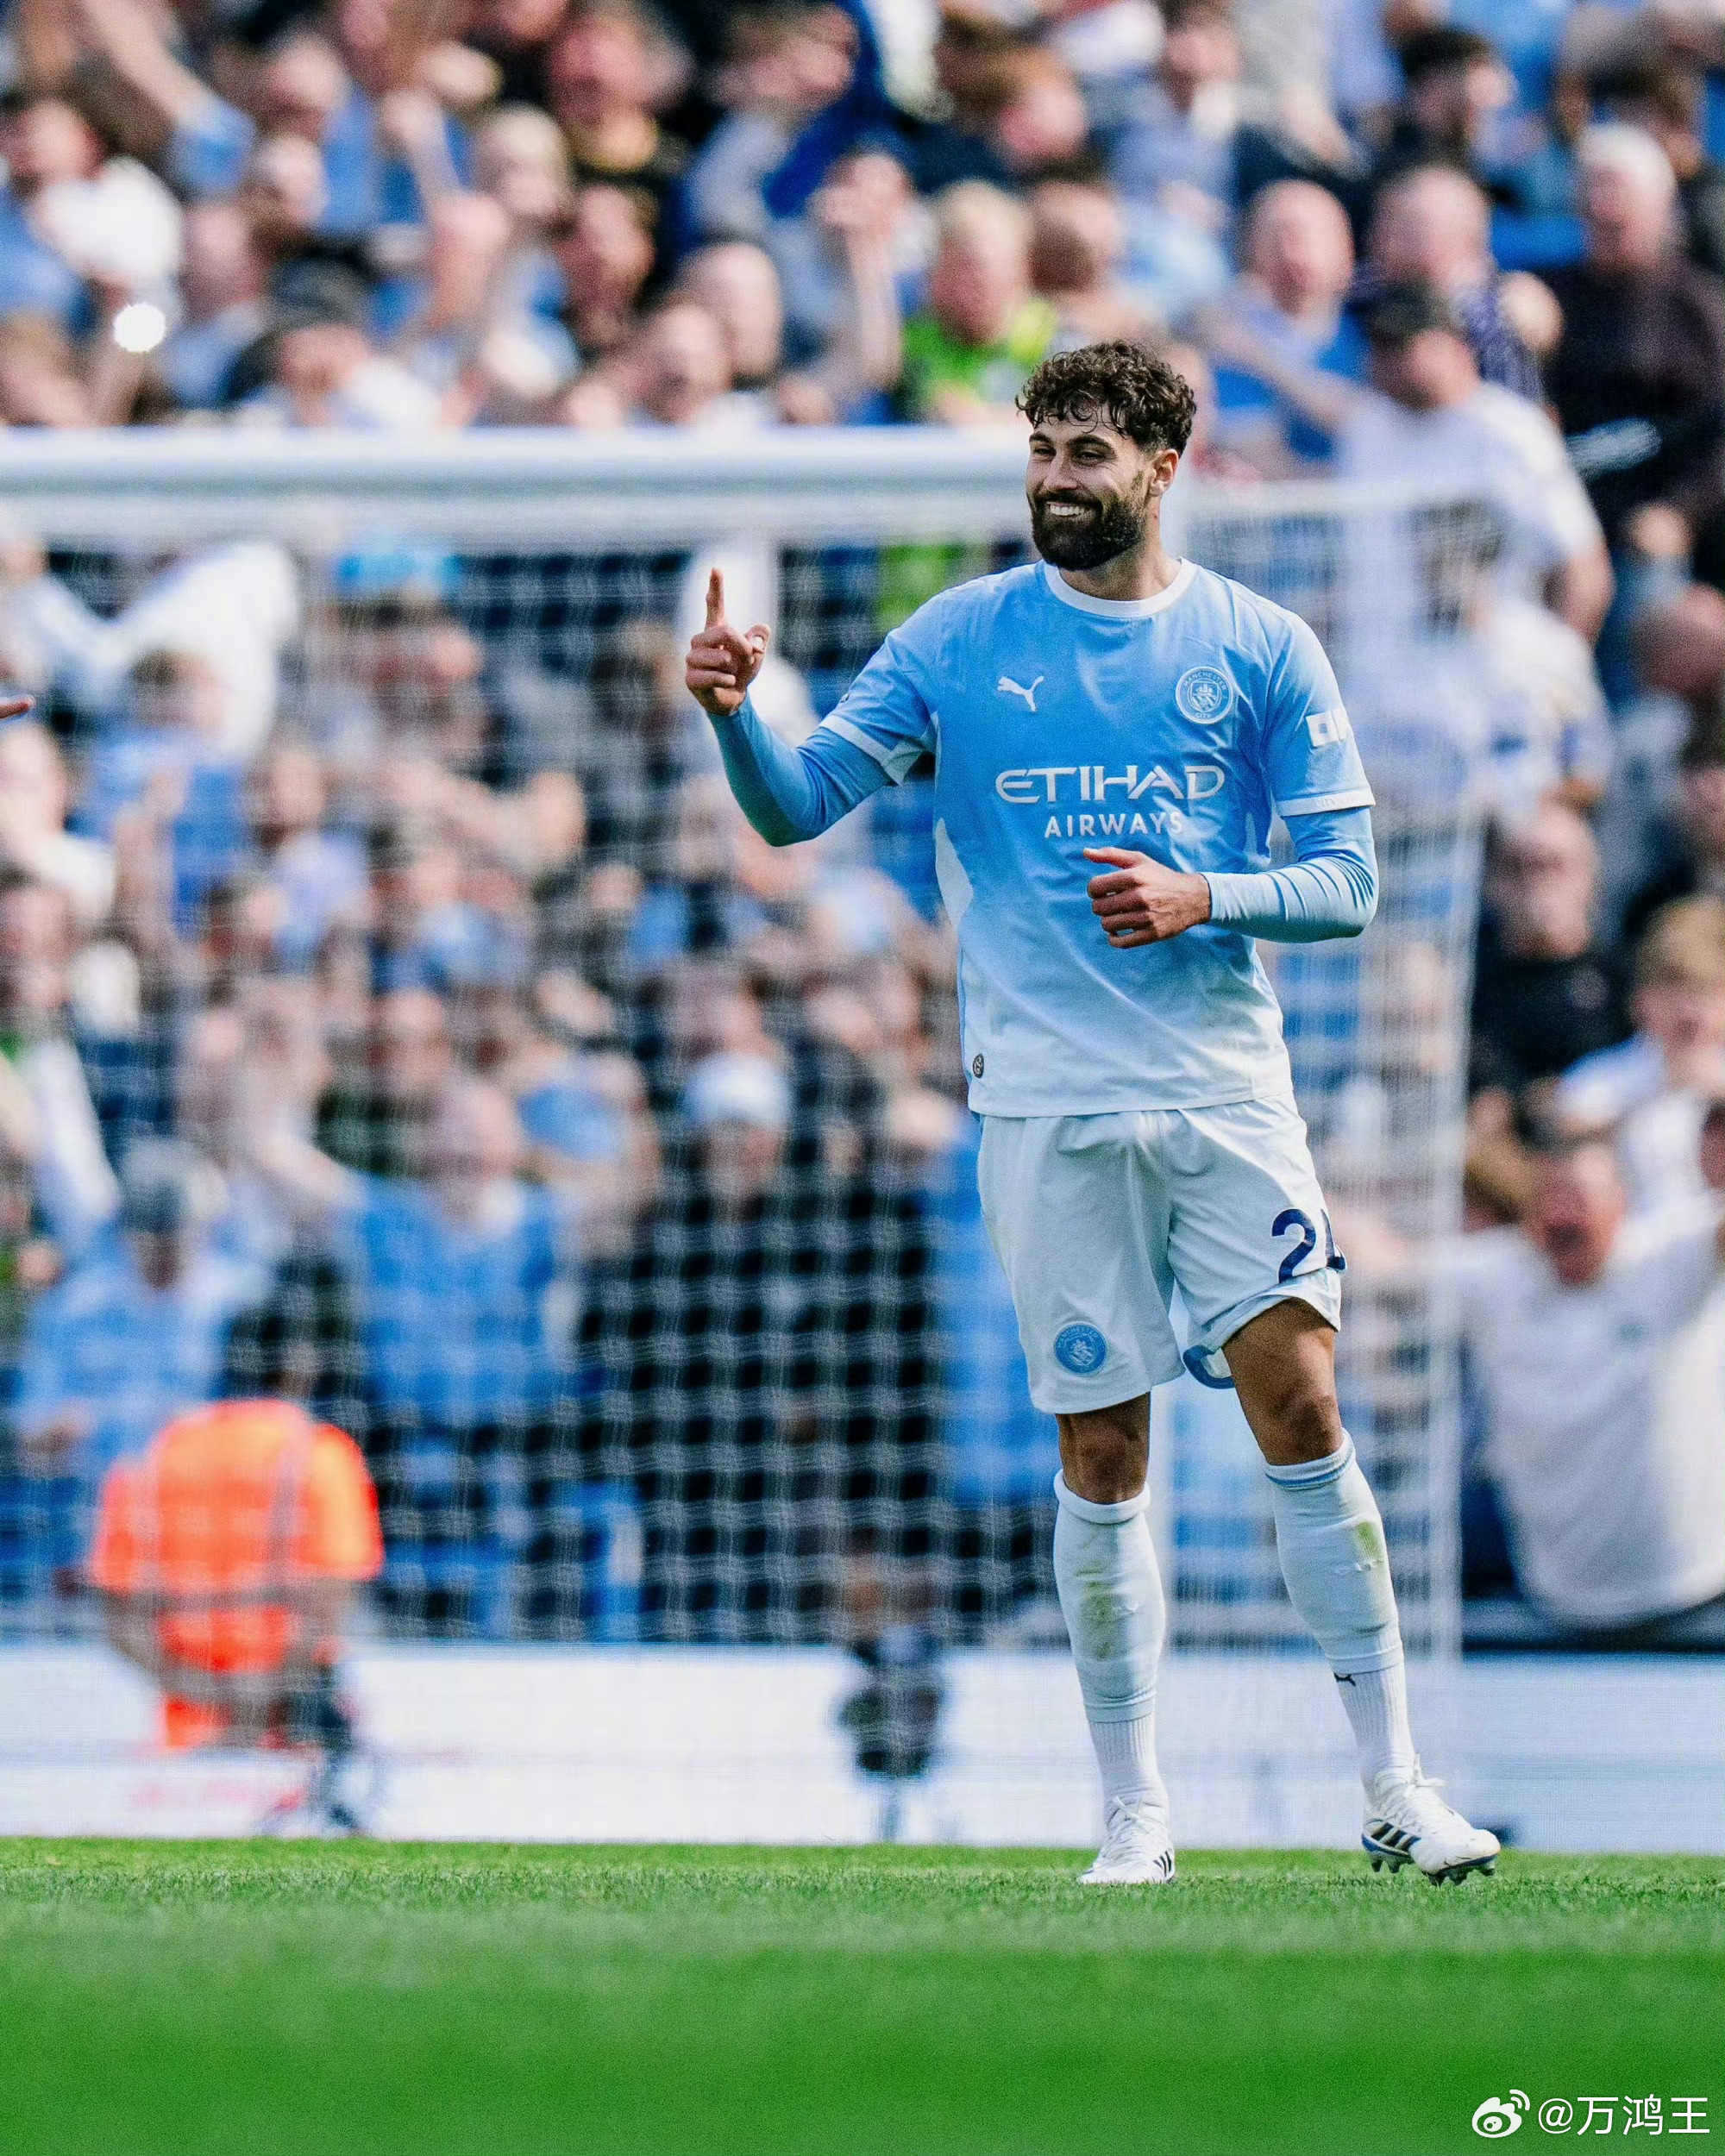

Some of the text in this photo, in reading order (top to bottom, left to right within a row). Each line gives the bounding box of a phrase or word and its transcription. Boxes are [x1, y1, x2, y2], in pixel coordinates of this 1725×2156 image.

[1183, 670, 1226, 690] MANCHESTER
[995, 765, 1226, 804] ETIHAD
[1044, 812, 1184, 839] AIRWAYS
